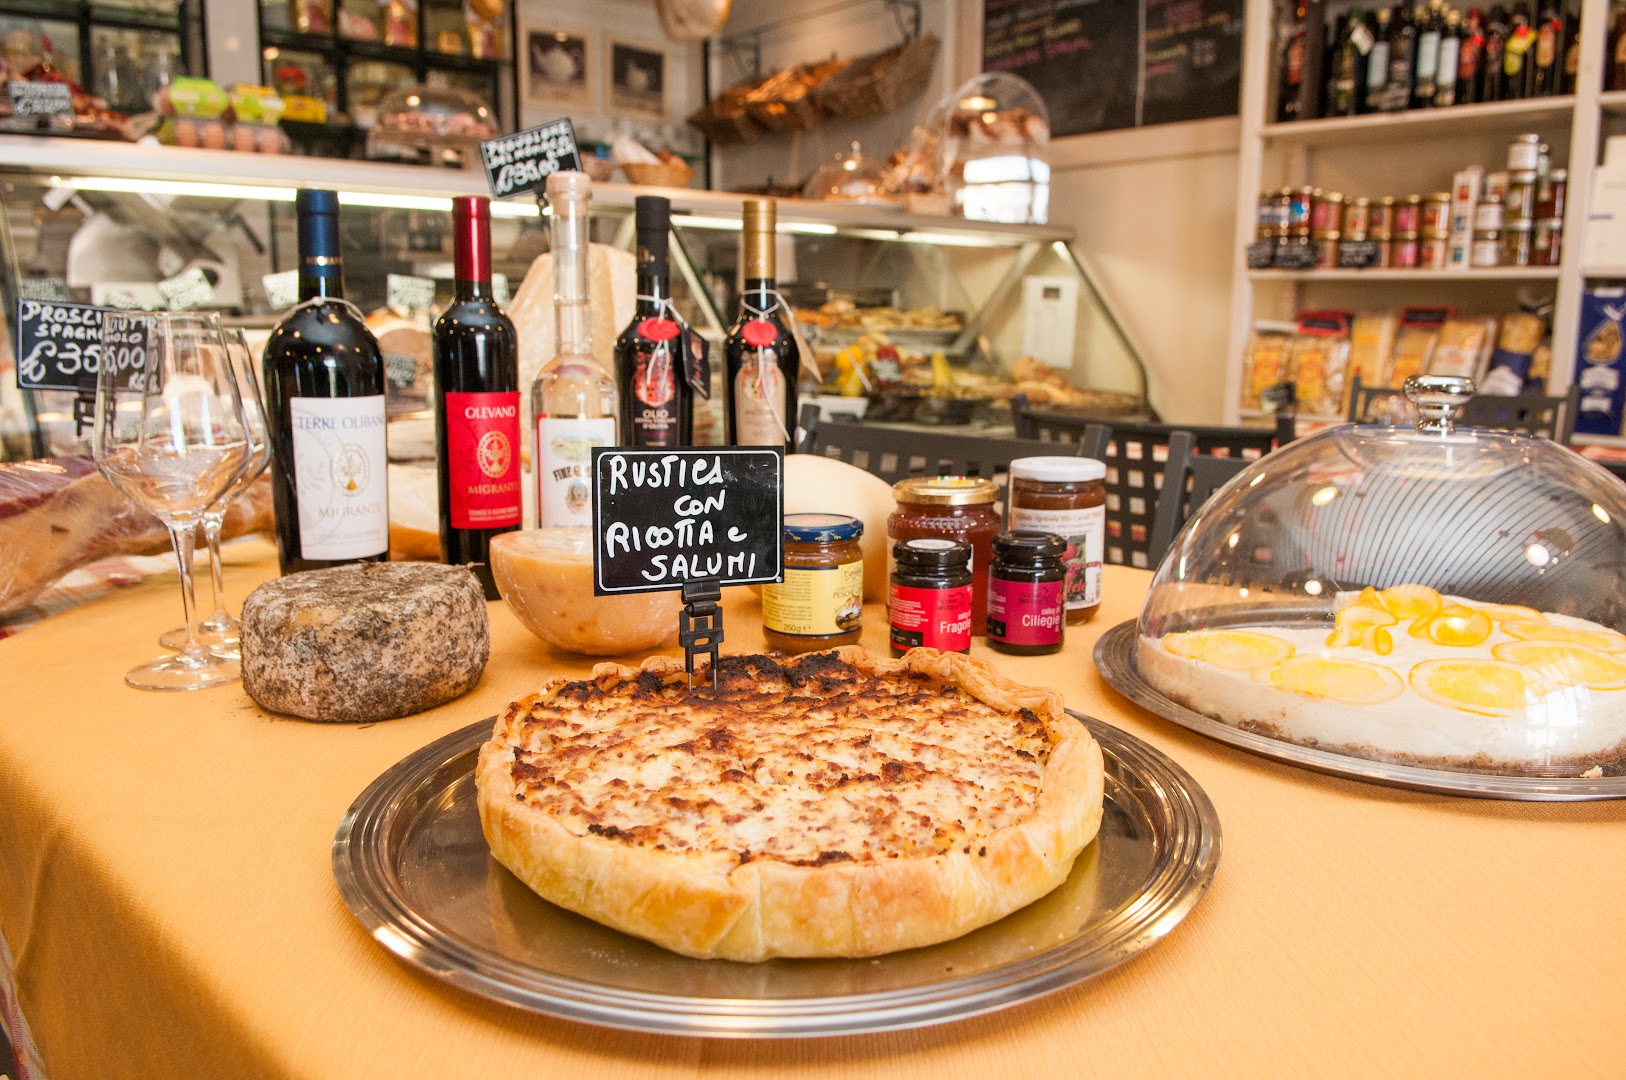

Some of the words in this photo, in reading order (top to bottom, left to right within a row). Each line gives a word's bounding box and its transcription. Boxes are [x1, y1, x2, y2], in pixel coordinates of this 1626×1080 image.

[464, 405, 517, 419] OLEVANO
[642, 409, 669, 419] OLIO
[299, 417, 335, 430] TERRE
[342, 414, 384, 430] OLIBAN
[673, 489, 726, 517] CON
[606, 518, 714, 558] RICOTTA
[641, 551, 756, 582] SALUMI
[783, 623, 801, 633] 250g
[1022, 614, 1060, 628] Ciliegie
